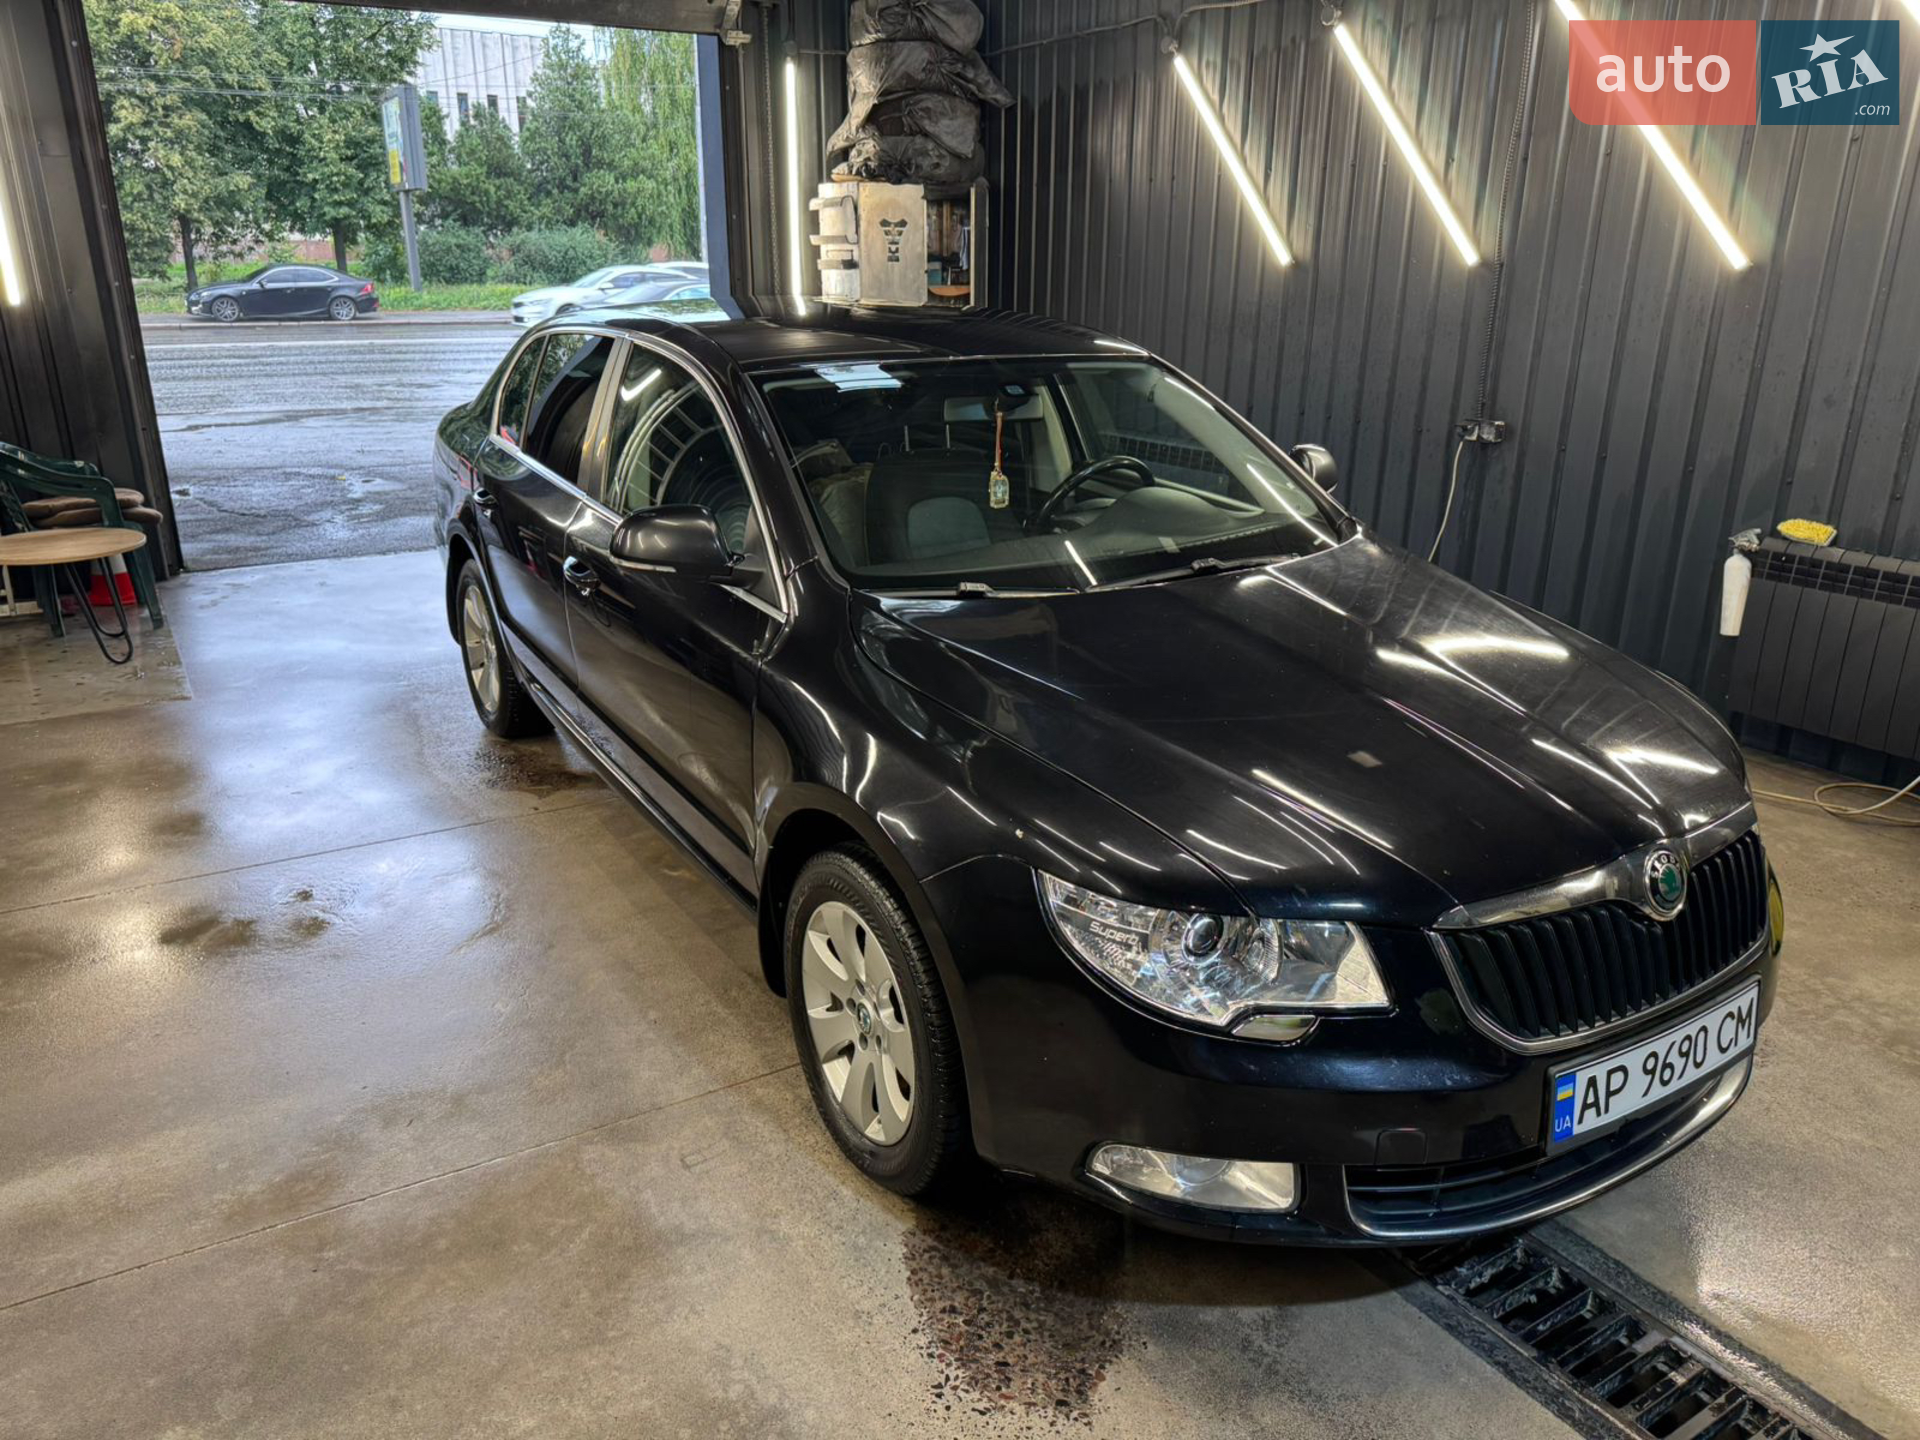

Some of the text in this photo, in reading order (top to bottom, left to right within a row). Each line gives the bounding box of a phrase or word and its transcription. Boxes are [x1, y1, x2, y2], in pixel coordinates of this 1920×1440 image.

[1089, 920, 1140, 946] Superb
[1554, 997, 1754, 1133] UA AP 9690 CM
